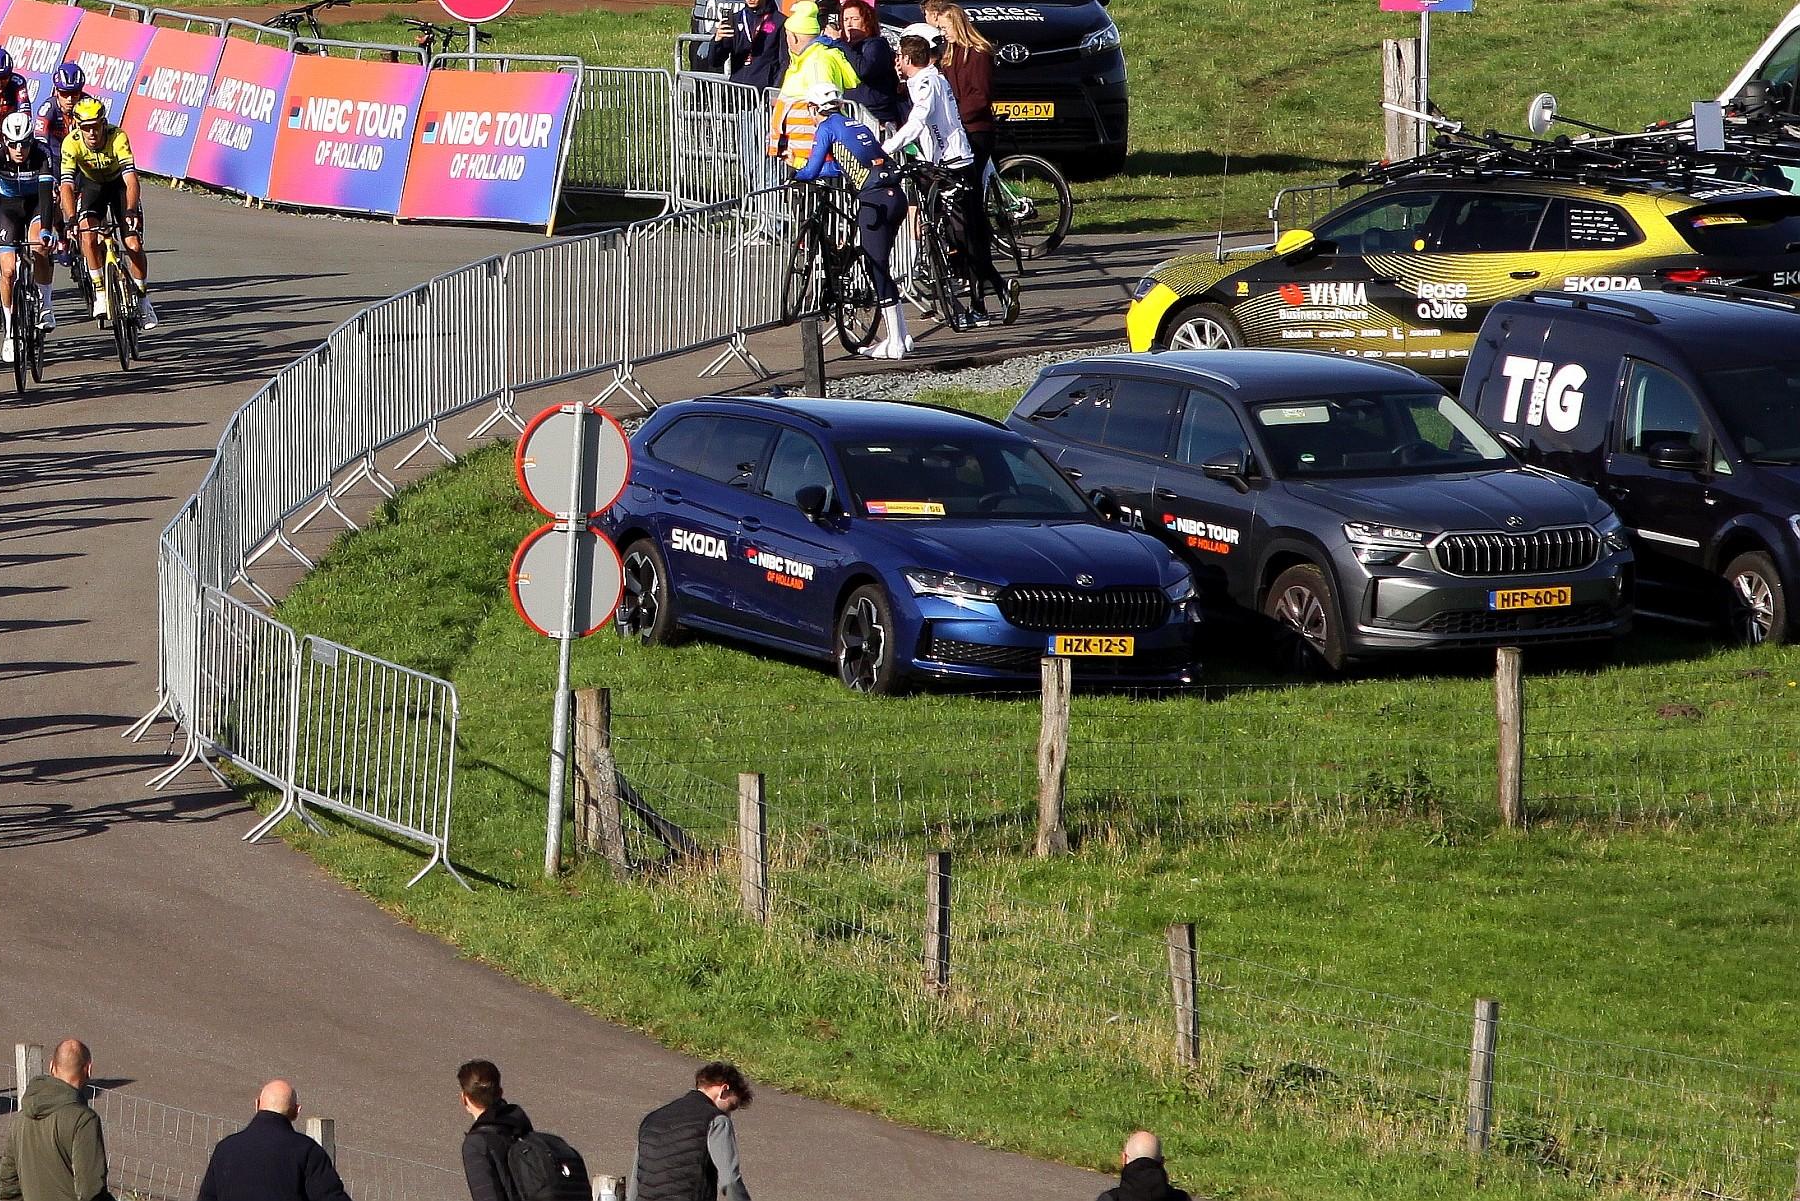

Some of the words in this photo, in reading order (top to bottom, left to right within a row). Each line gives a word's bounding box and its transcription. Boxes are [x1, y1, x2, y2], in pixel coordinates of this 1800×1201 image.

[26, 39, 62, 75] TOUR
[100, 55, 136, 94] TOUR
[148, 66, 181, 104] NIBC
[176, 71, 209, 110] TOUR
[235, 80, 277, 125] TOUR
[304, 96, 354, 134] NIBC
[355, 100, 408, 140] TOUR
[439, 111, 492, 146] NIBC
[494, 112, 553, 148] TOUR
[314, 140, 333, 166] OF
[330, 142, 385, 172] HOLLAND
[449, 153, 468, 179] OF
[465, 154, 526, 181] HOLLAND
[1310, 282, 1368, 306] VISMA
[1417, 280, 1468, 299] lease
[1279, 308, 1323, 320] Business
[1324, 308, 1369, 320] software
[1176, 517, 1206, 537] NIBC
[1206, 523, 1240, 545] TOUR
[1197, 539, 1230, 554] HOLLAND
[758, 552, 784, 572] NIBC
[784, 559, 814, 581] TOUR
[767, 571, 776, 583] OF
[775, 573, 804, 590] HOLLAND
[1501, 589, 1567, 609] HFP-60-D
[1063, 638, 1127, 653] HZK-12-S
